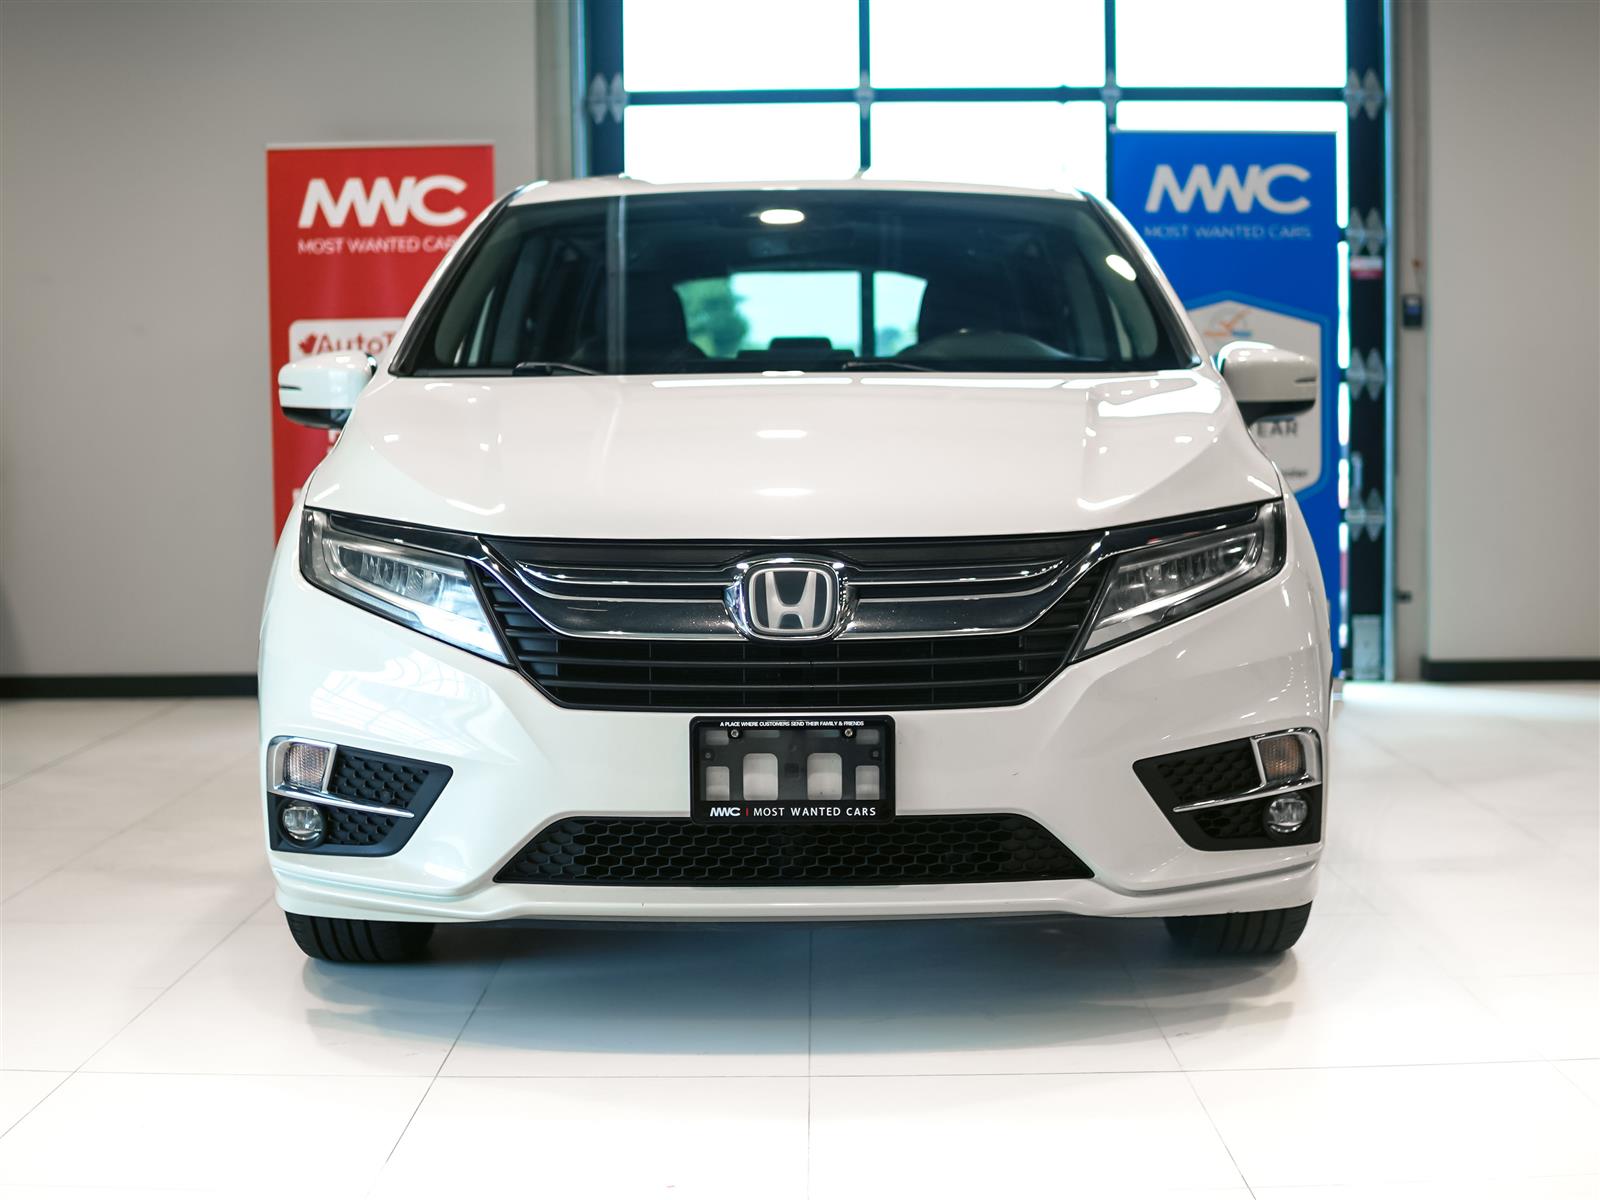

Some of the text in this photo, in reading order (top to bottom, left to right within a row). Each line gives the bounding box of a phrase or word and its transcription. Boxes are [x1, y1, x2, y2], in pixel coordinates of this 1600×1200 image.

[1144, 224, 1311, 239] MOST WANTED CARS
[298, 236, 344, 255] MOST
[347, 235, 420, 254] WANTED
[753, 807, 785, 816] MOST
[790, 807, 840, 816] WANTED
[846, 807, 876, 816] CARS
